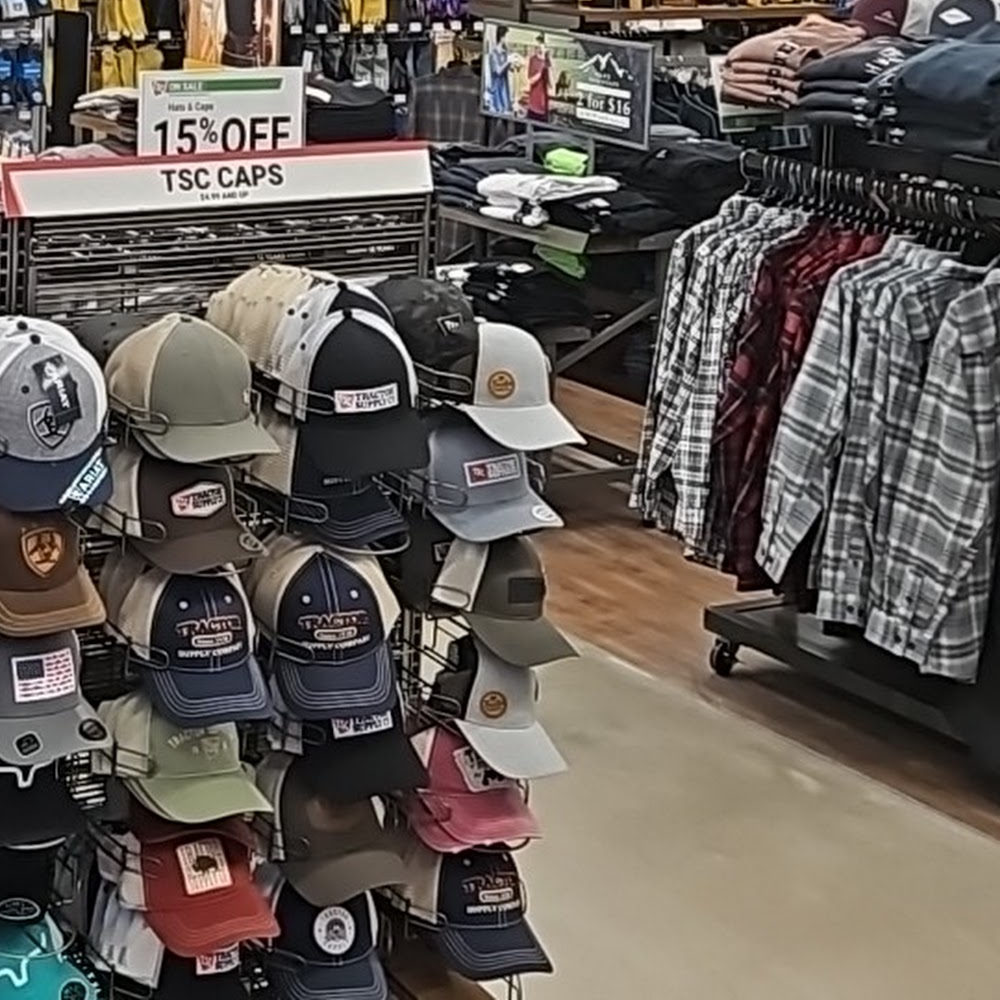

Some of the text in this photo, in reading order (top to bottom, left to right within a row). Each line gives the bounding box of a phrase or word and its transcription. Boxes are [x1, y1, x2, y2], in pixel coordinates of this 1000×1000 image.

[169, 81, 183, 91] ON
[184, 81, 204, 91] SALE
[168, 101, 214, 112] Hats & Caps
[608, 98, 631, 116] $16
[161, 164, 284, 193] TSC CAPS
[239, 191, 249, 199] UP
[77, 458, 105, 493] ARIAT
